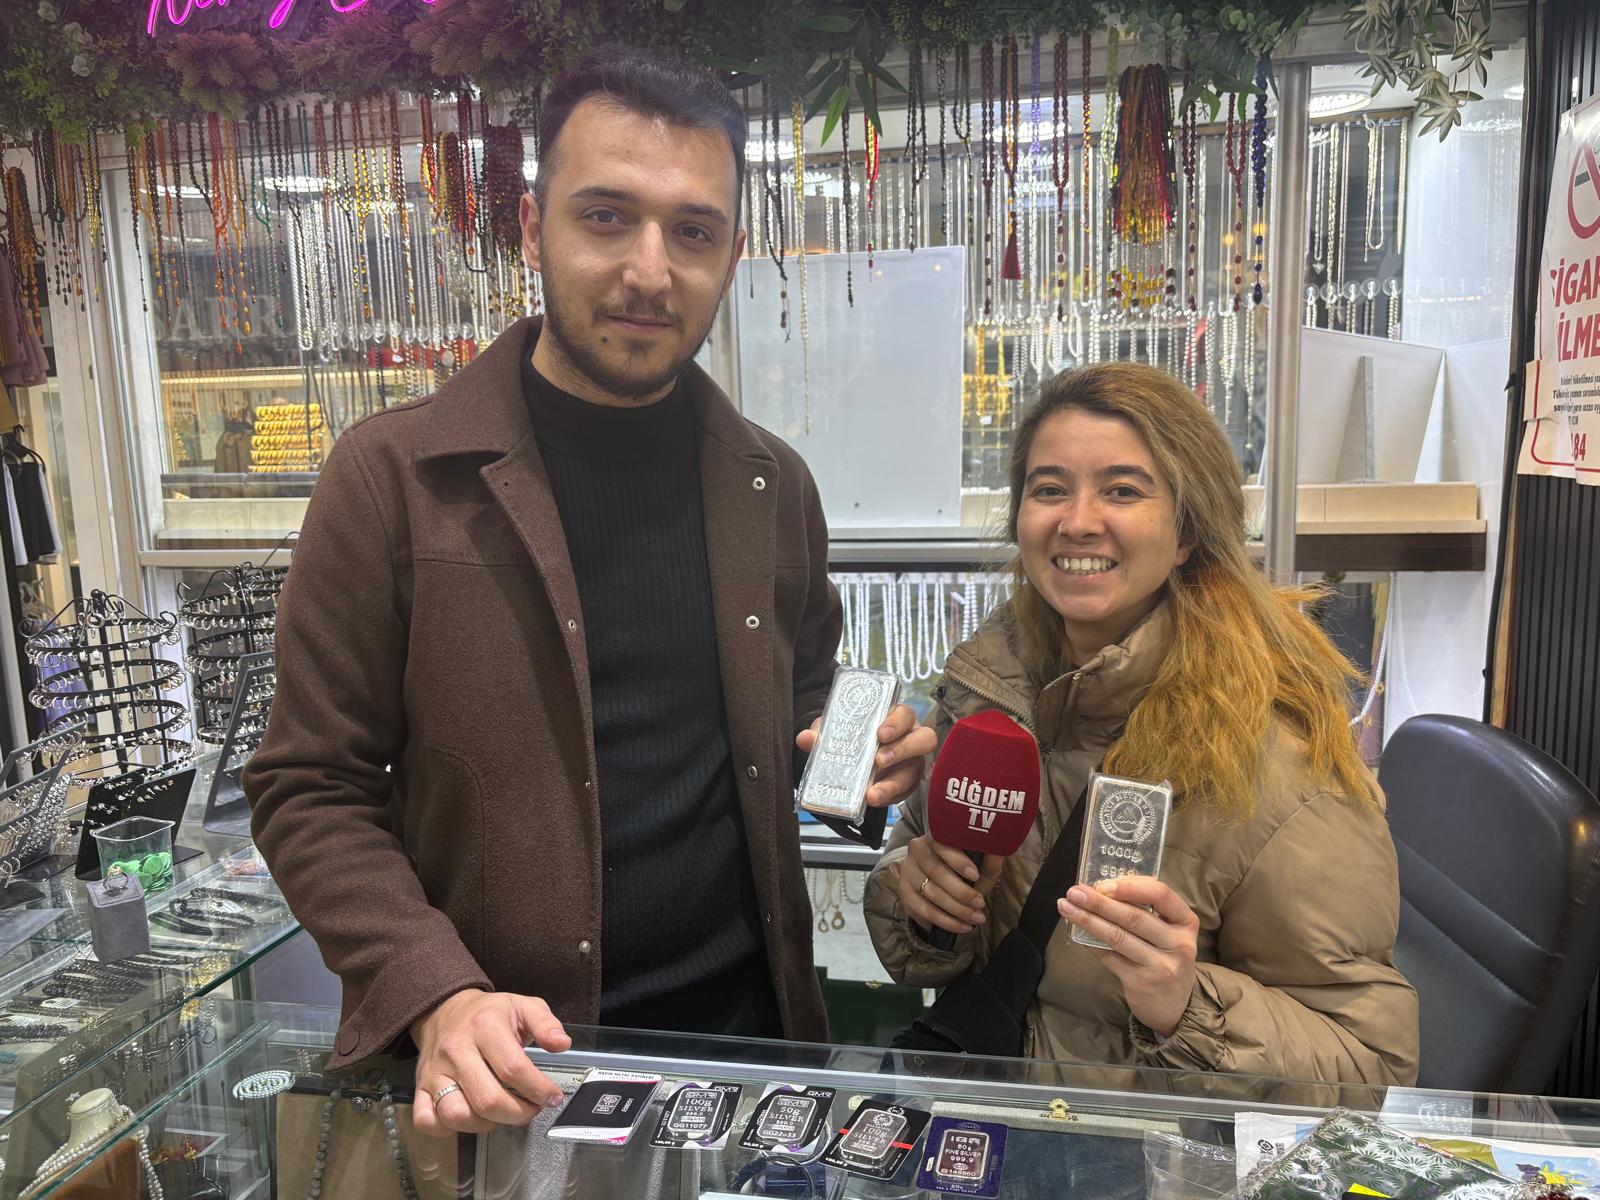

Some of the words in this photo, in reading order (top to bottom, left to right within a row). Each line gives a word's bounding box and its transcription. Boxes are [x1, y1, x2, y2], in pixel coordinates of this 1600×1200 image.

[946, 776, 1026, 811] ÇİĞDEM
[969, 807, 997, 829] TV
[686, 1099, 713, 1107] 100g
[780, 1107, 801, 1116] 50g
[769, 1112, 805, 1123] SILVER
[853, 1132, 887, 1144] SILVER
[862, 1126, 888, 1139] 100g
[960, 1150, 982, 1158] SILVER
